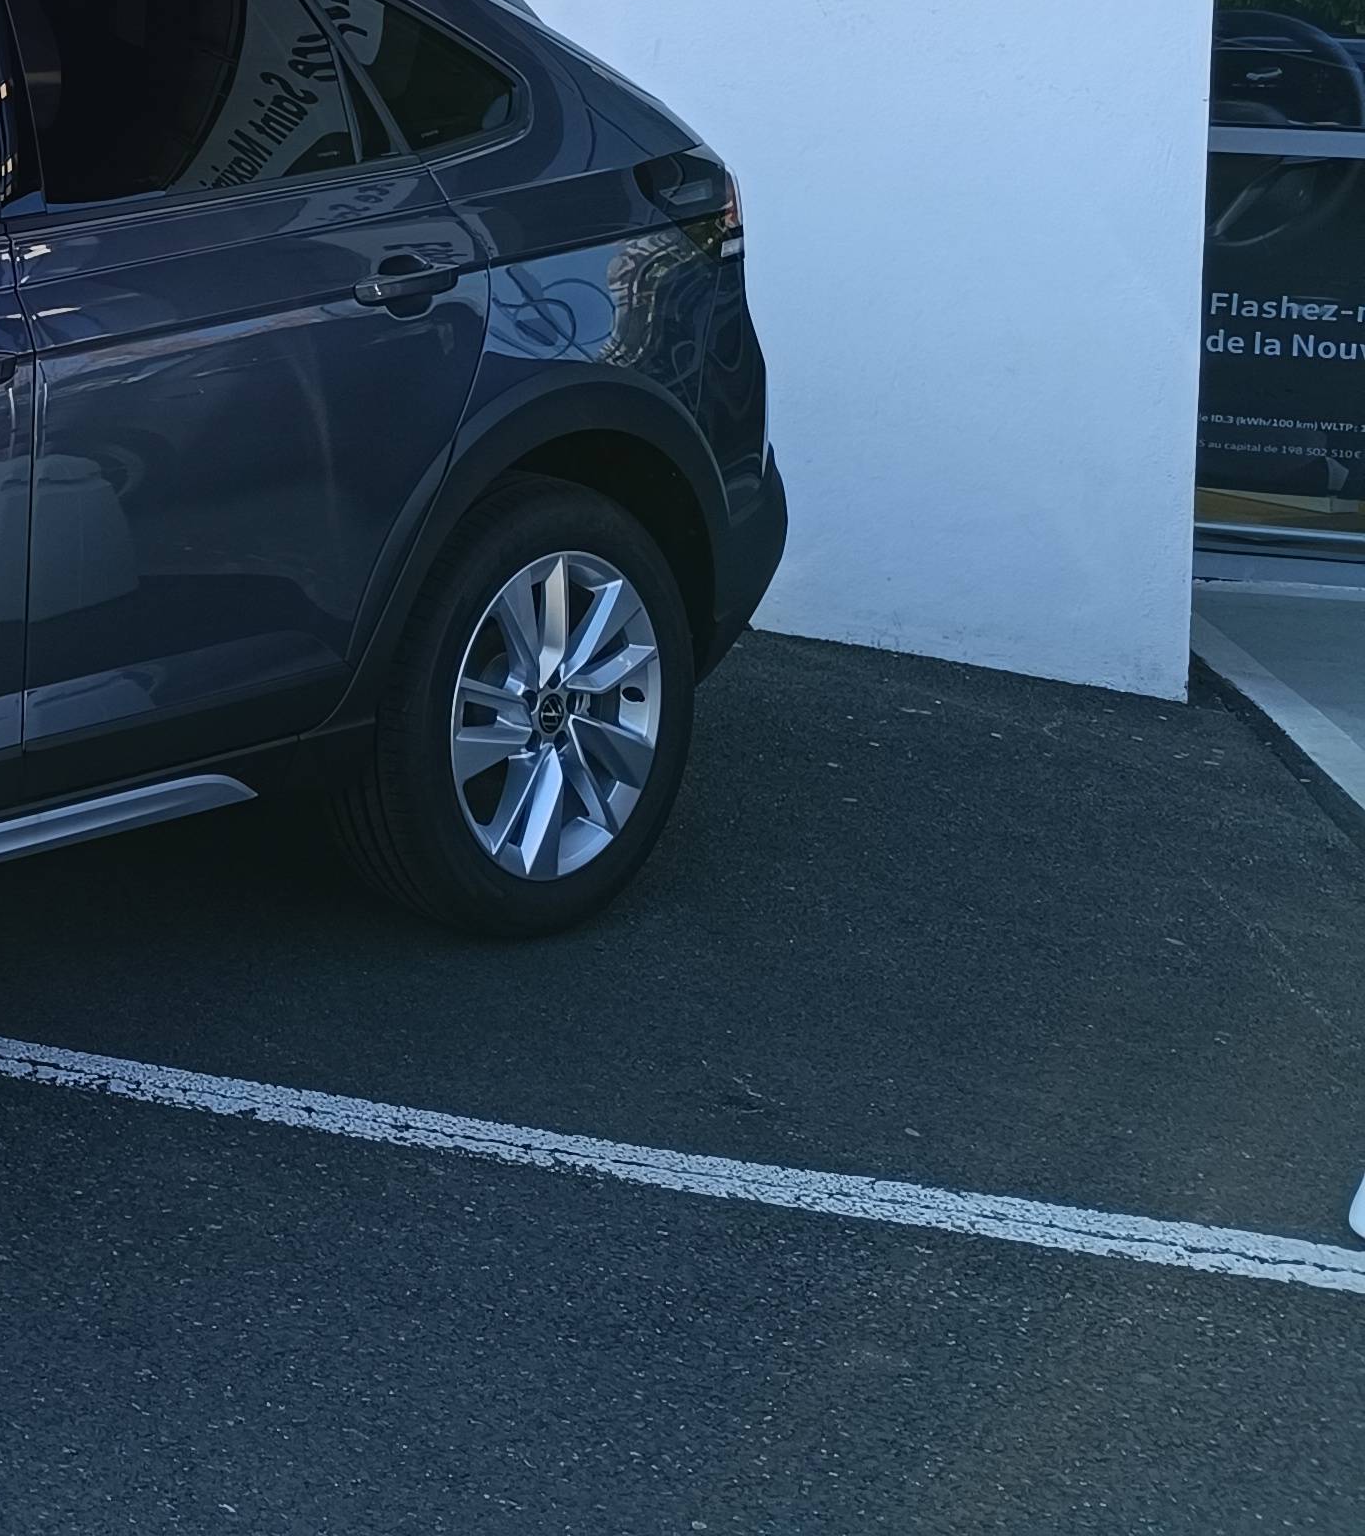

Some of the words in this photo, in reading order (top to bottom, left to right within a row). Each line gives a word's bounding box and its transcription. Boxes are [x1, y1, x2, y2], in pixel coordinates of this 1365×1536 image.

[1205, 328, 1245, 354] de
[1254, 331, 1282, 357] la
[1295, 419, 1318, 432] km)
[1224, 442, 1261, 453] capital
[1263, 444, 1278, 454] de
